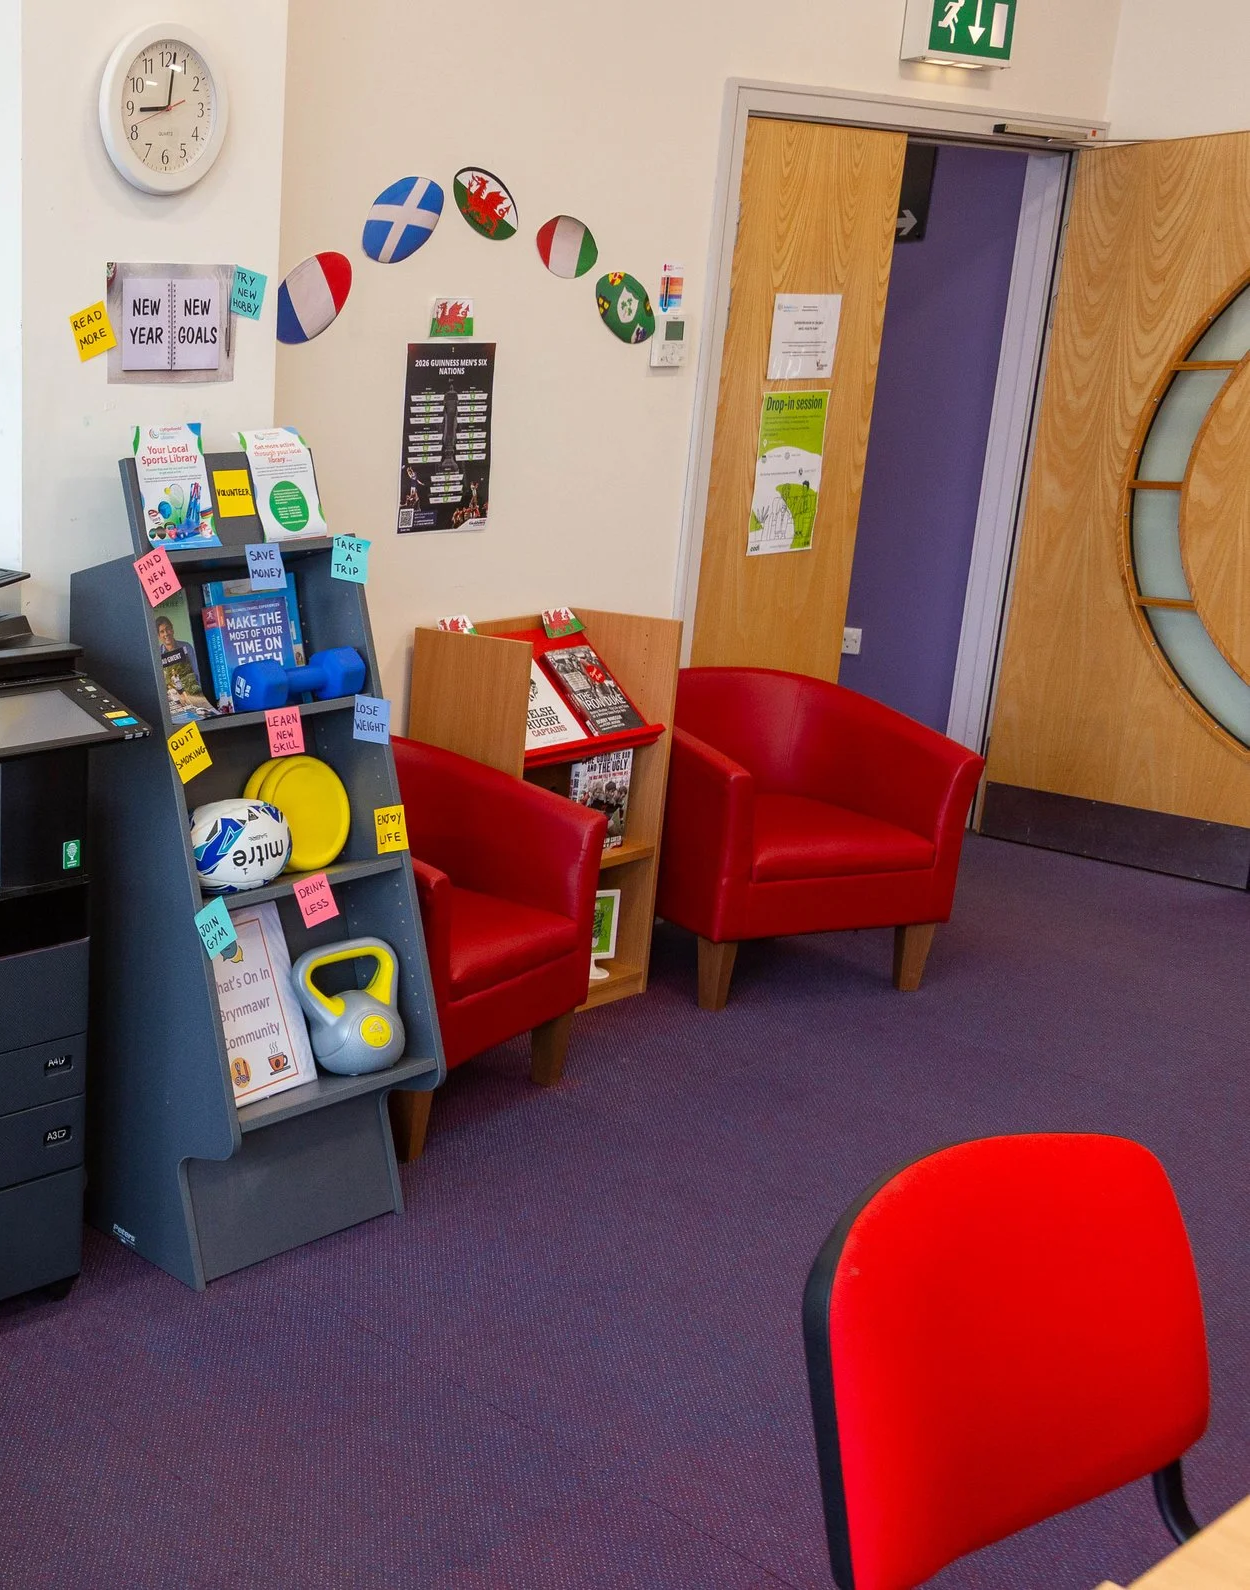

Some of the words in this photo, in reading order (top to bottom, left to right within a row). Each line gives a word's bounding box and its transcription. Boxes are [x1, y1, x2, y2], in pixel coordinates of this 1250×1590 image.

[143, 59, 152, 74] 11
[158, 52, 172, 67] 12
[182, 60, 186, 74] 1
[130, 77, 144, 93] 10
[192, 76, 200, 91] 2
[126, 101, 134, 116] 9
[198, 102, 204, 117] 3
[131, 125, 138, 140] 8
[192, 127, 199, 141] 4
[145, 144, 152, 158] 7
[162, 150, 169, 164] 6
[180, 144, 186, 158] 5
[237, 271, 255, 286] TRY
[238, 287, 256, 299] NEW
[133, 298, 160, 316] NEW
[184, 298, 211, 316] NEW
[233, 298, 259, 316] HOBBY
[73, 310, 102, 331] READ
[79, 328, 107, 350] MORE
[130, 327, 163, 345] YEAR
[178, 326, 217, 345] GOALS
[767, 396, 794, 414] Drop-in
[796, 395, 823, 409] session
[147, 446, 166, 455] Your
[167, 444, 188, 453] Local
[142, 456, 168, 466] Sports
[169, 454, 197, 464] Library
[335, 538, 362, 552] TAKE
[750, 542, 760, 552] codi
[138, 554, 162, 574] FIND
[250, 551, 275, 562] SAVE
[345, 554, 352, 562] A
[148, 567, 166, 585] NEW
[251, 568, 282, 579] MONEY
[334, 563, 359, 575] TRIP
[152, 582, 172, 599] JOB
[226, 614, 257, 630] MAKE
[259, 611, 282, 624] THE
[229, 631, 249, 640] MOST
[251, 629, 260, 638] OF
[262, 626, 282, 636] YOUR
[234, 639, 262, 655] TIME
[265, 636, 282, 650] ON
[356, 702, 379, 716] LOSE
[583, 699, 605, 710] IRON
[604, 695, 627, 706] DUKE
[268, 715, 298, 727] LEARN
[354, 718, 386, 733] WEIGHT
[528, 716, 561, 730] RUGBY
[277, 730, 294, 740] NEW
[532, 725, 567, 737] CAPTAINS
[171, 728, 194, 751] QUIT
[273, 740, 300, 753] SKILL
[176, 745, 206, 769] SMOKING
[587, 764, 597, 772] AND
[599, 763, 610, 774] THE
[612, 759, 628, 771] UGLY
[379, 832, 401, 844] LIFE
[233, 839, 284, 866] mitre
[298, 882, 325, 899] DRINK
[305, 899, 329, 916] LESS
[200, 916, 219, 937] JOIN
[207, 928, 228, 950] GYM
[217, 976, 241, 994] hat's
[244, 972, 257, 985] On
[259, 967, 270, 979] In
[220, 996, 270, 1023] Brynmawr
[226, 1022, 280, 1050] Community
[48, 1058, 58, 1067] A4
[47, 1131, 57, 1141] A3
